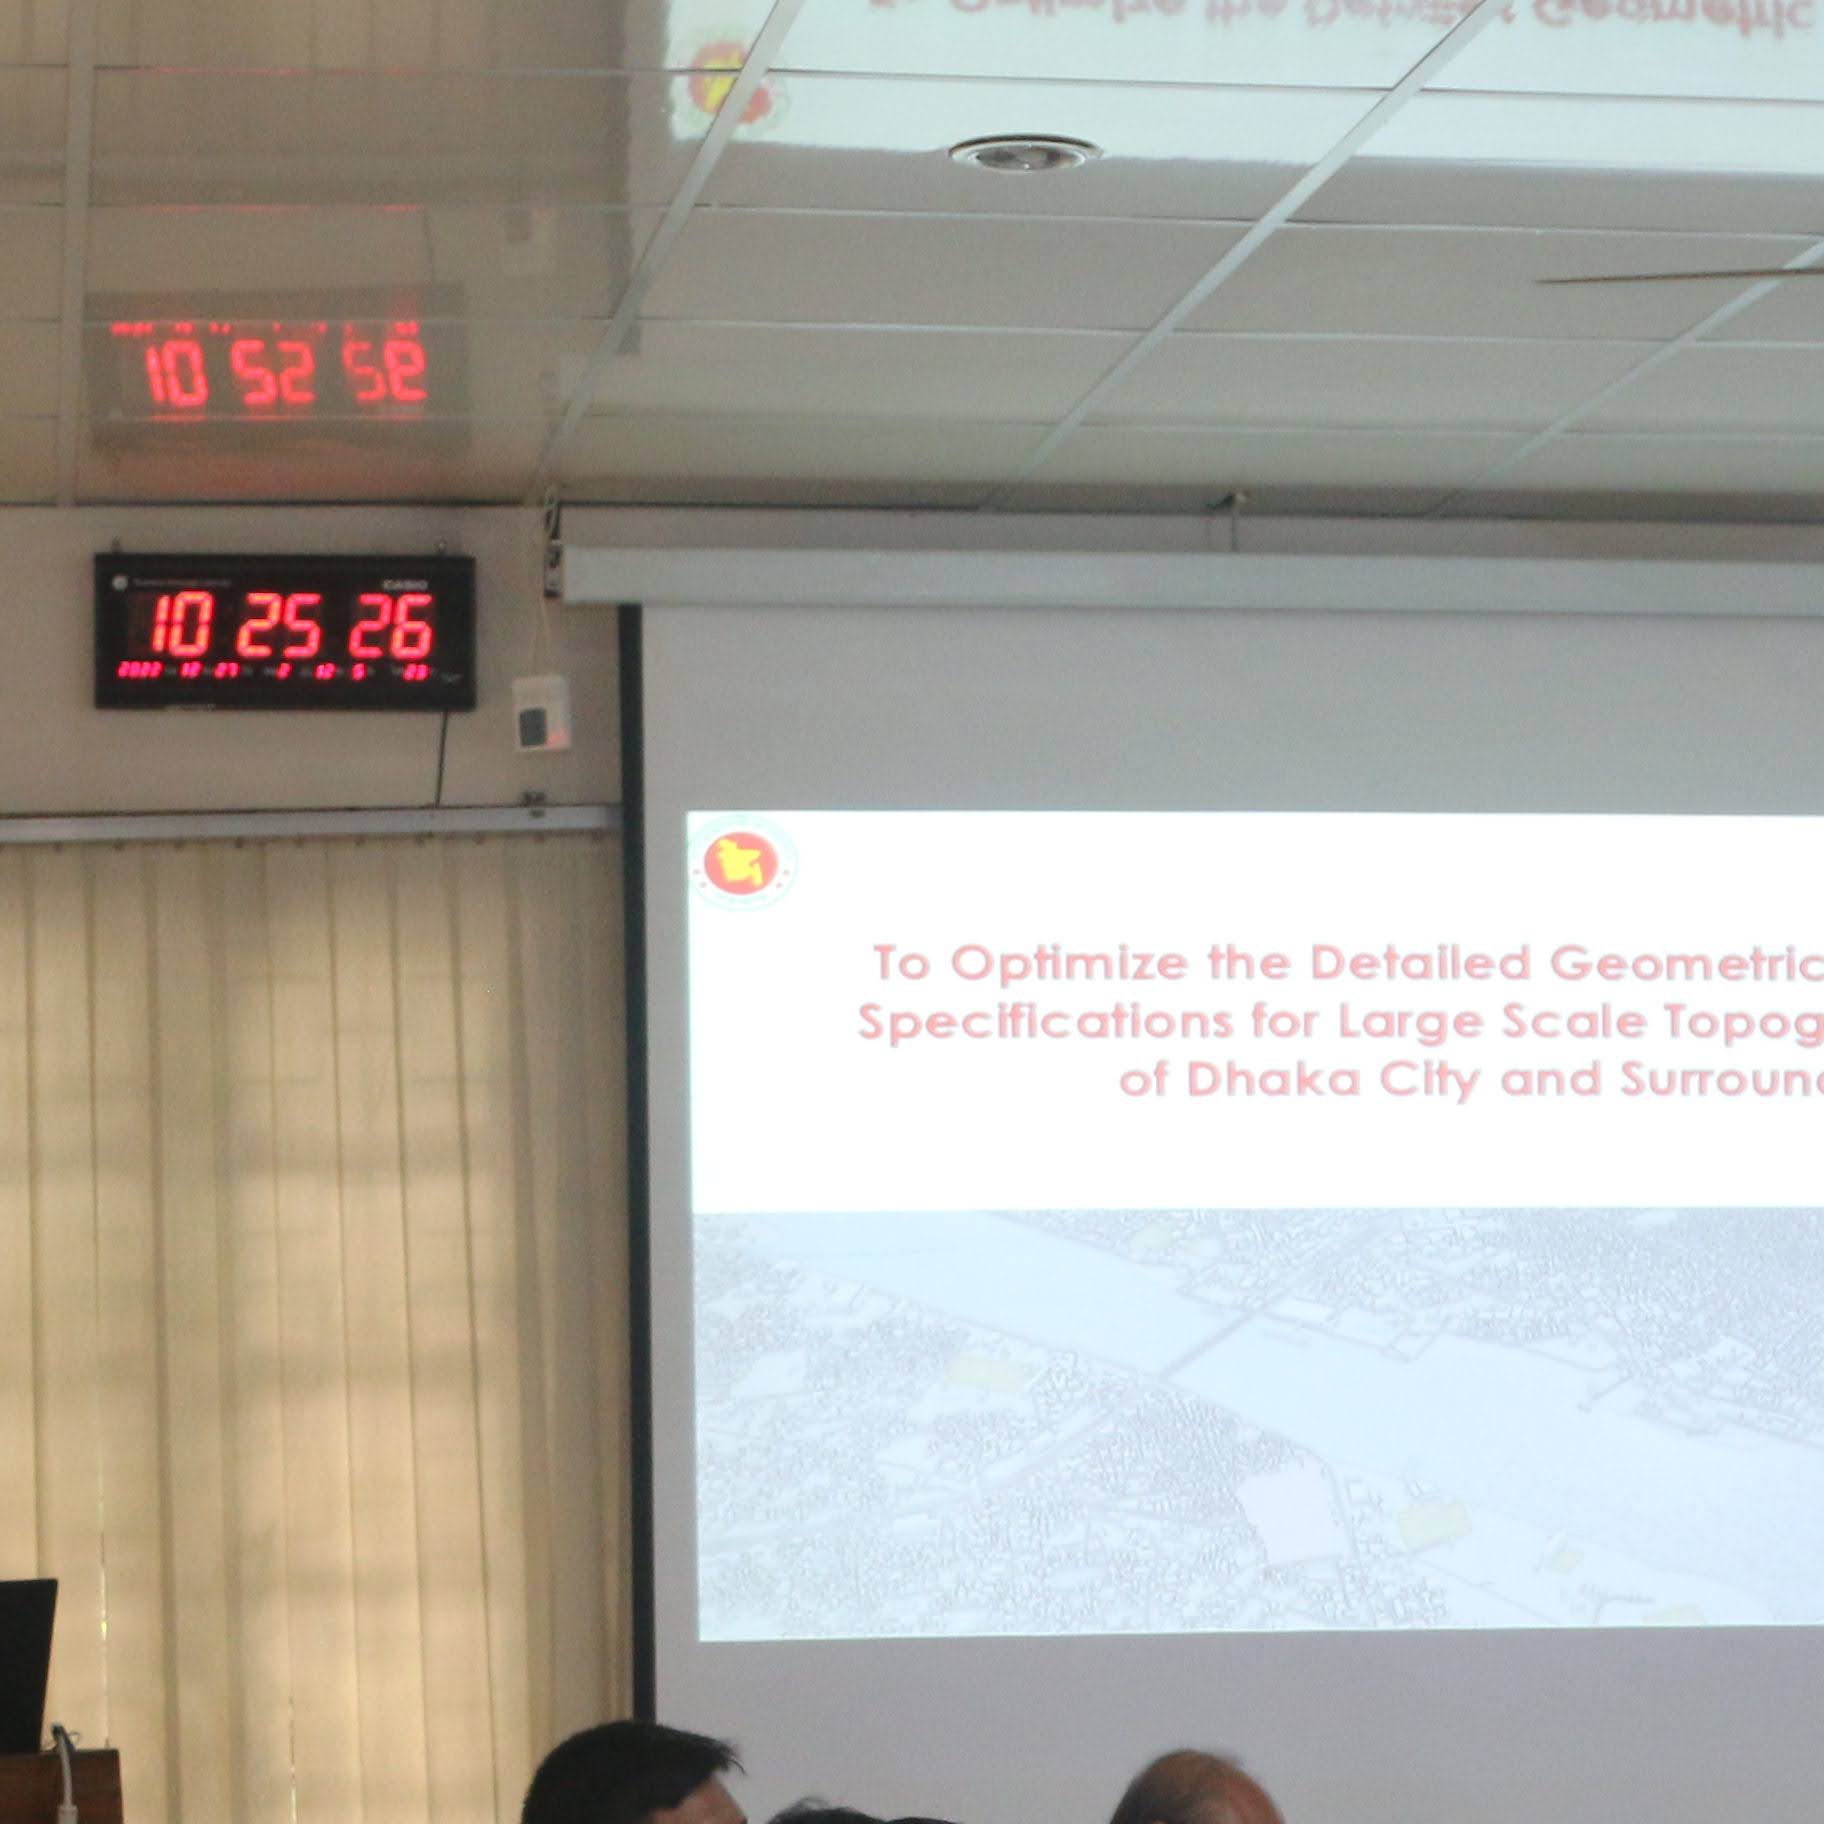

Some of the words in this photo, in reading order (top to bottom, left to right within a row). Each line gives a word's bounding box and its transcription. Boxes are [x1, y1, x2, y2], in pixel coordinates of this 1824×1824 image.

[152, 590, 214, 657] 10
[237, 592, 322, 659] 25
[349, 593, 433, 659] 26
[873, 943, 930, 981] To
[951, 943, 1188, 989] Optimize
[1207, 943, 1291, 980] the
[1312, 943, 1530, 981] Detailed
[858, 1001, 1234, 1048] Specifications
[1251, 1001, 1319, 1038] for
[1339, 1002, 1484, 1048] Large
[1503, 1002, 1647, 1039] Scale
[1119, 1060, 1169, 1097] of
[1188, 1060, 1361, 1097] Dhaka
[1380, 1059, 1481, 1105] City
[1501, 1060, 1601, 1097] and
